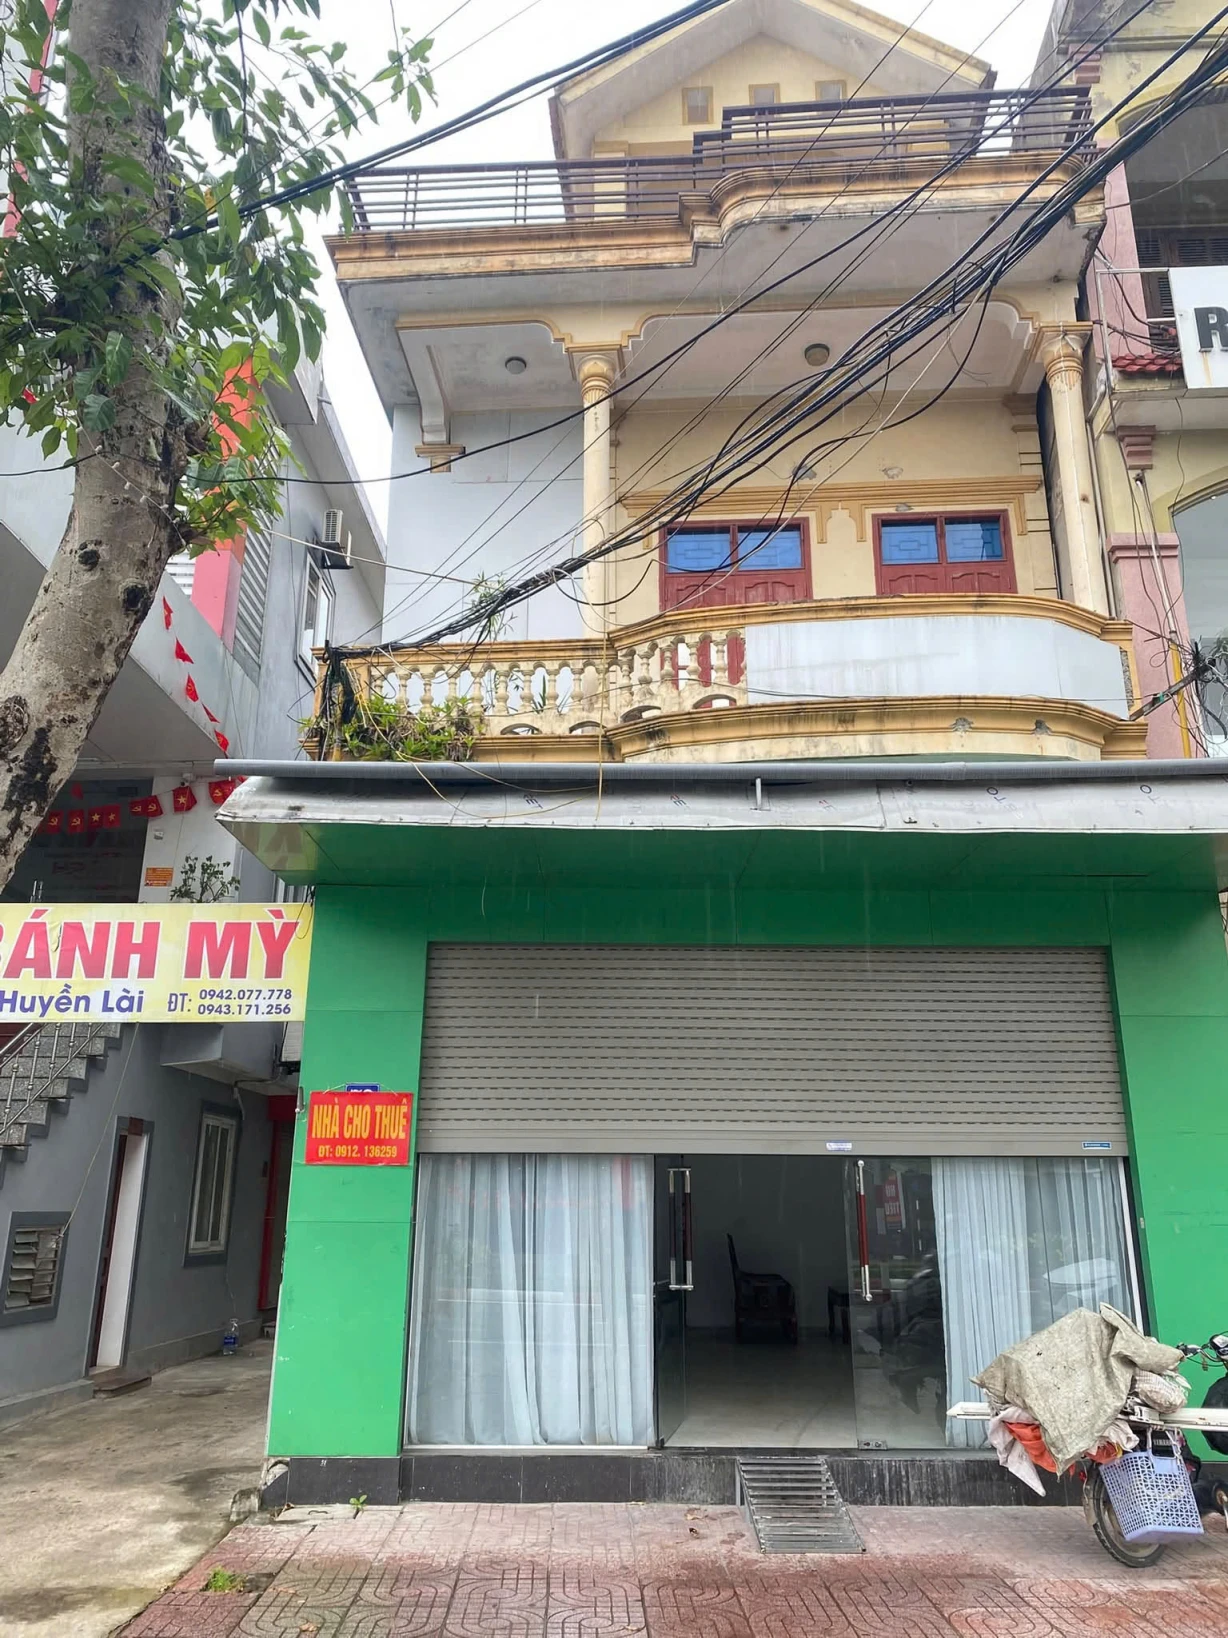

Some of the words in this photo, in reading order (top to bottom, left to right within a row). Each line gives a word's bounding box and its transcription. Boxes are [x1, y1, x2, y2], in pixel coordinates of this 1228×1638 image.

[0, 908, 161, 979] ÁNH
[183, 908, 300, 979] MỲ
[0, 983, 91, 1018] Huyền
[101, 987, 144, 1013] Lài
[167, 993, 192, 1012] ĐT:
[199, 989, 292, 1000] 0942.077.778
[198, 1004, 291, 1015] 0943.171.256
[312, 1097, 339, 1138] NHÀ
[344, 1104, 371, 1139] CHO
[375, 1098, 408, 1139] THUÊ
[335, 1145, 361, 1158] 0912.
[364, 1145, 398, 1158] 136259
